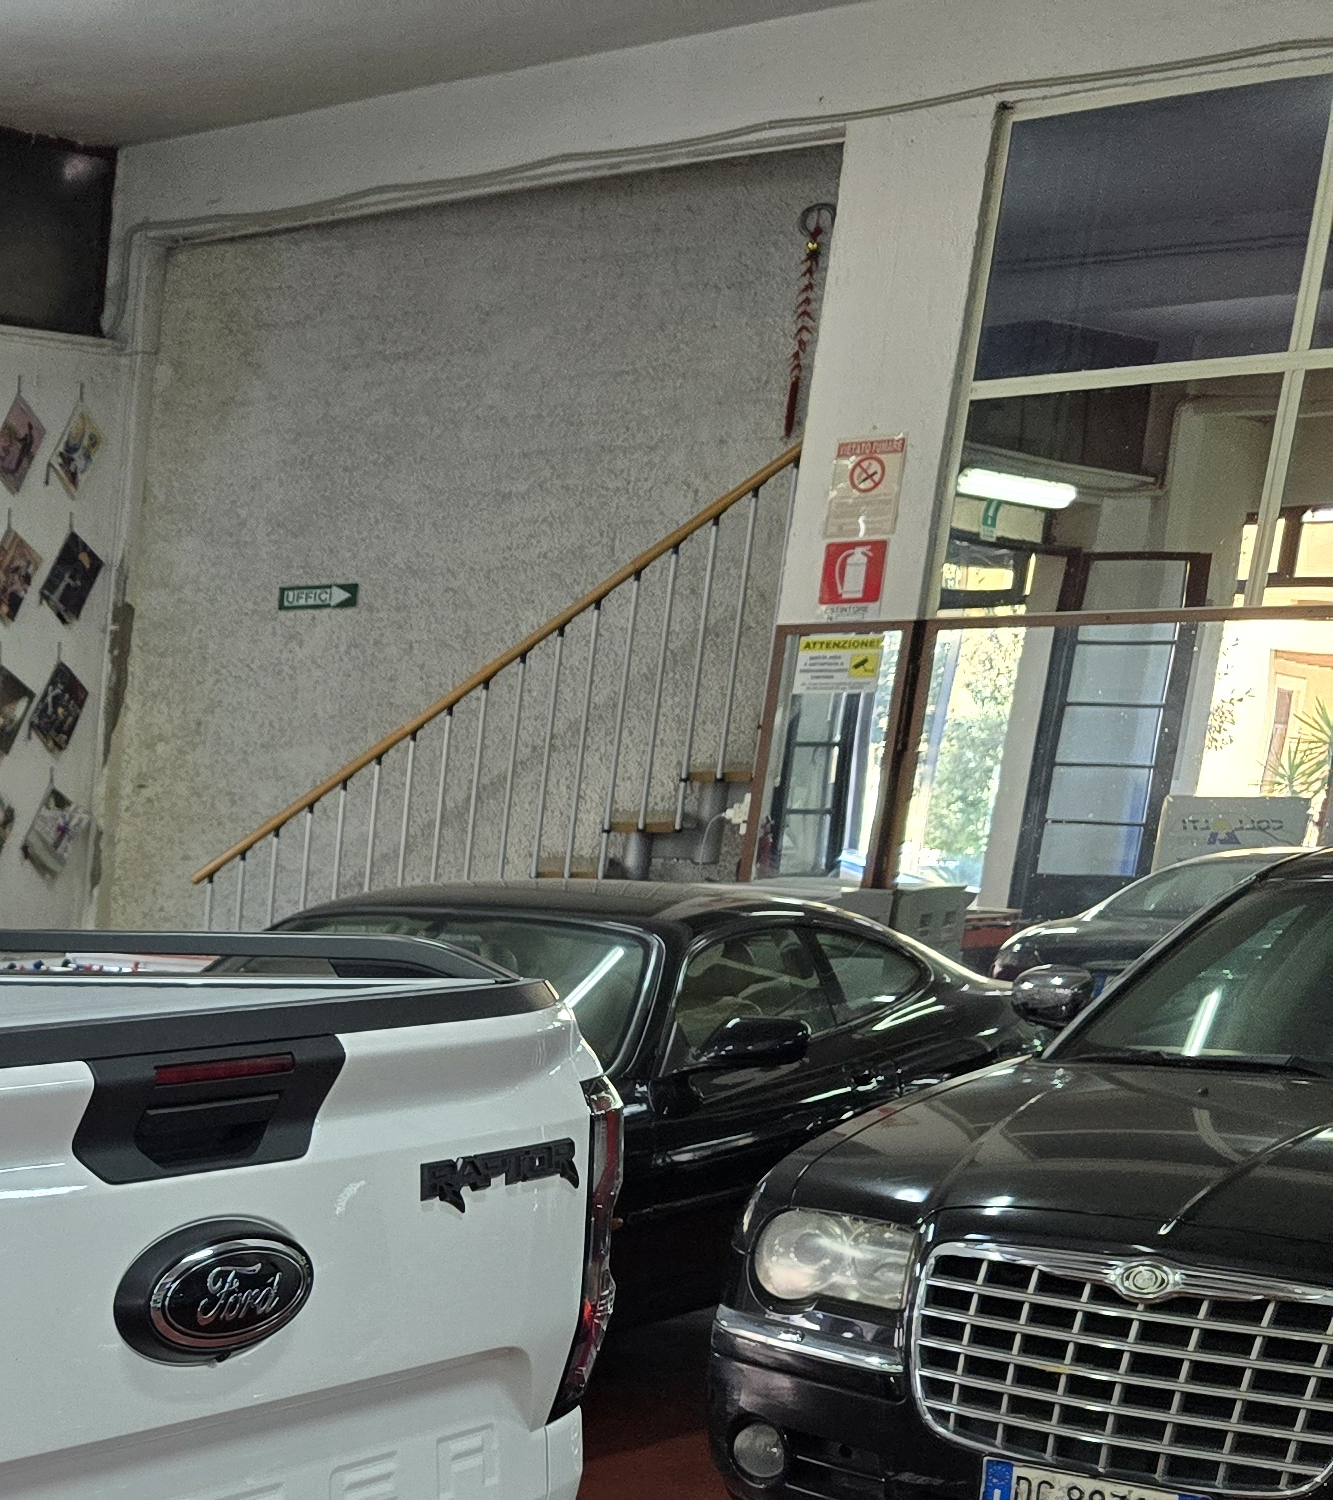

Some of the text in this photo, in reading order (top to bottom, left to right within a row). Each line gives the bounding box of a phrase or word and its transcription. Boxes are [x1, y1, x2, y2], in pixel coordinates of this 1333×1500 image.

[839, 439, 904, 455] VIETATO FUMARE
[803, 638, 880, 650] ATTENZIONE!
[420, 1137, 580, 1213] RAPTOR
[197, 1262, 283, 1326] Ford
